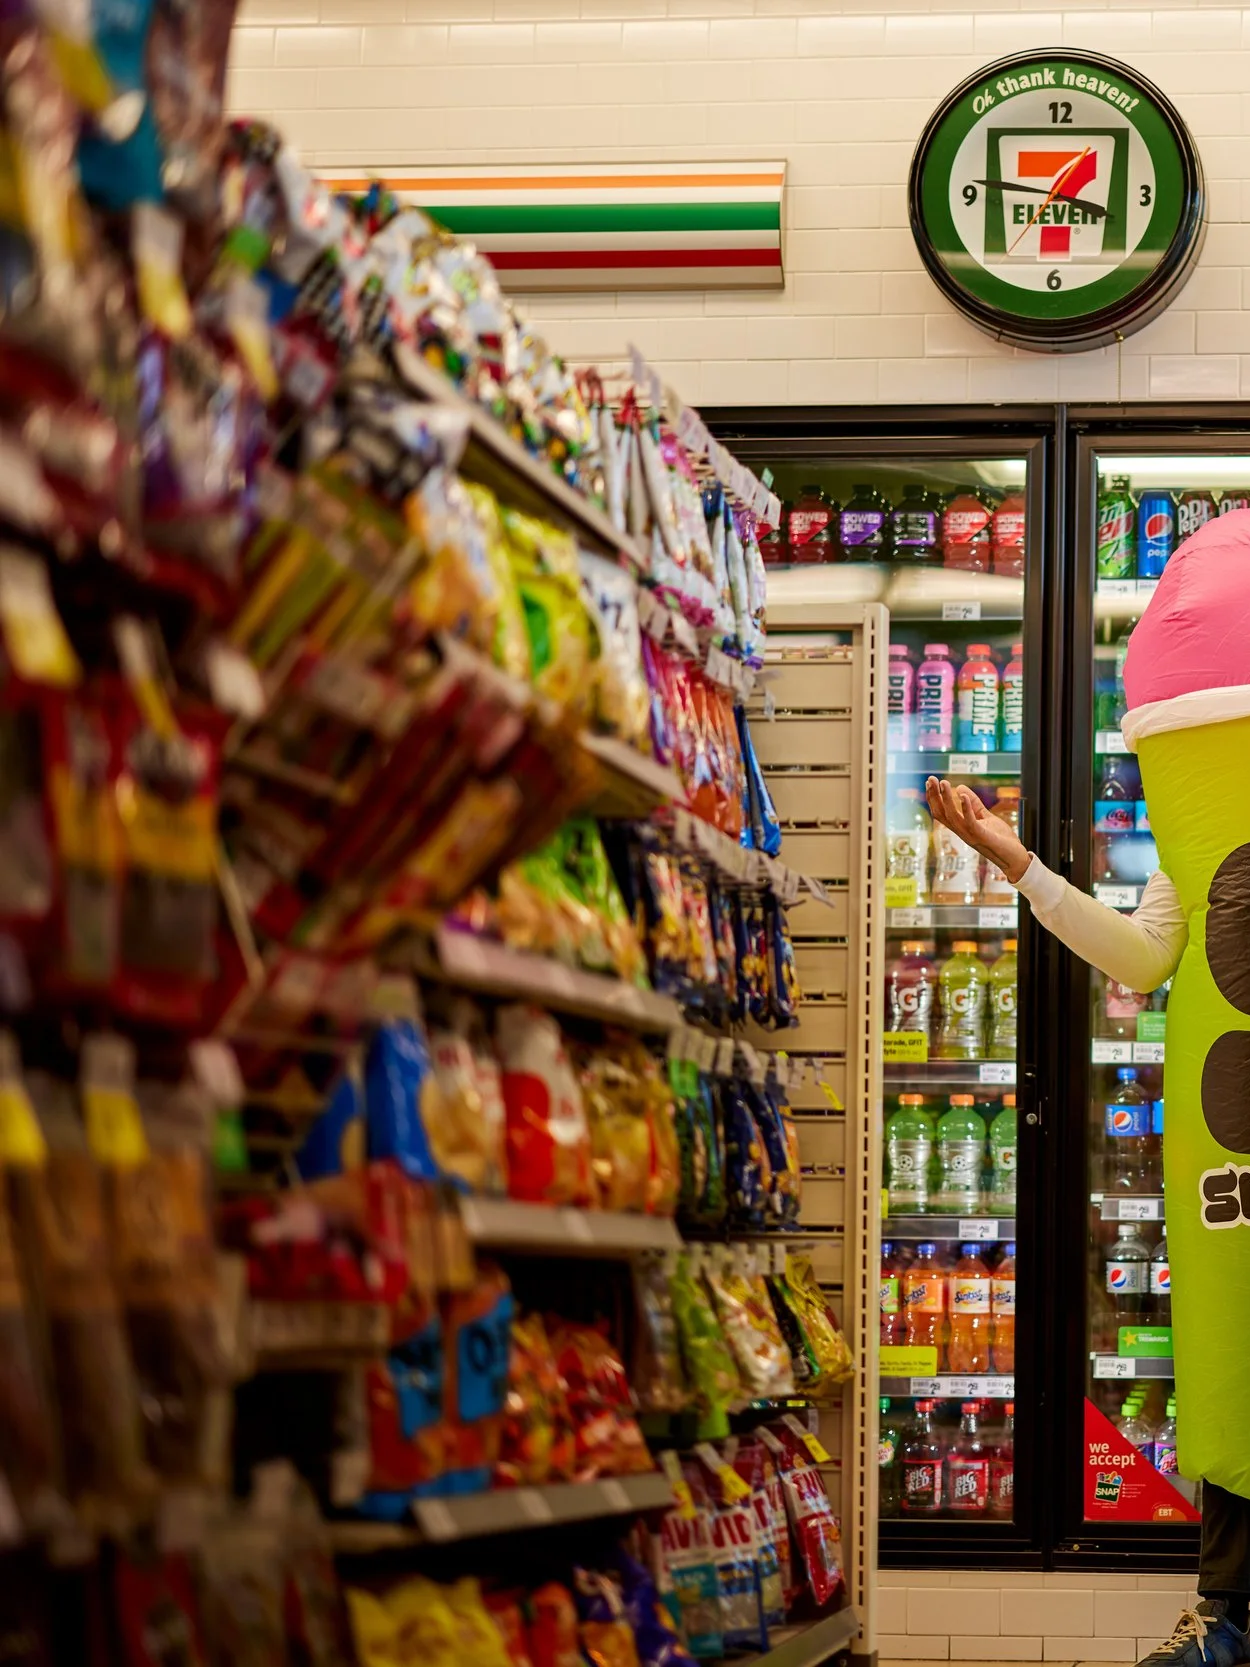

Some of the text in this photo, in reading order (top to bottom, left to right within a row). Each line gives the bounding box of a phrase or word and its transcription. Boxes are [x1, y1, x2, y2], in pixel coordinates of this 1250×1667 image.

[973, 68, 1140, 115] Oh thank heaven!
[1048, 102, 1073, 123] 12
[962, 185, 977, 207] 9
[1139, 185, 1151, 207] 3
[1046, 269, 1062, 291] 6
[972, 673, 997, 736] PRIME
[1089, 1443, 1110, 1454] we
[1089, 1453, 1136, 1468] accept
[955, 1470, 975, 1486] BIG
[954, 1480, 978, 1498] RED
[1095, 1487, 1119, 1497] SNAP
[1158, 1508, 1173, 1517] EBT
